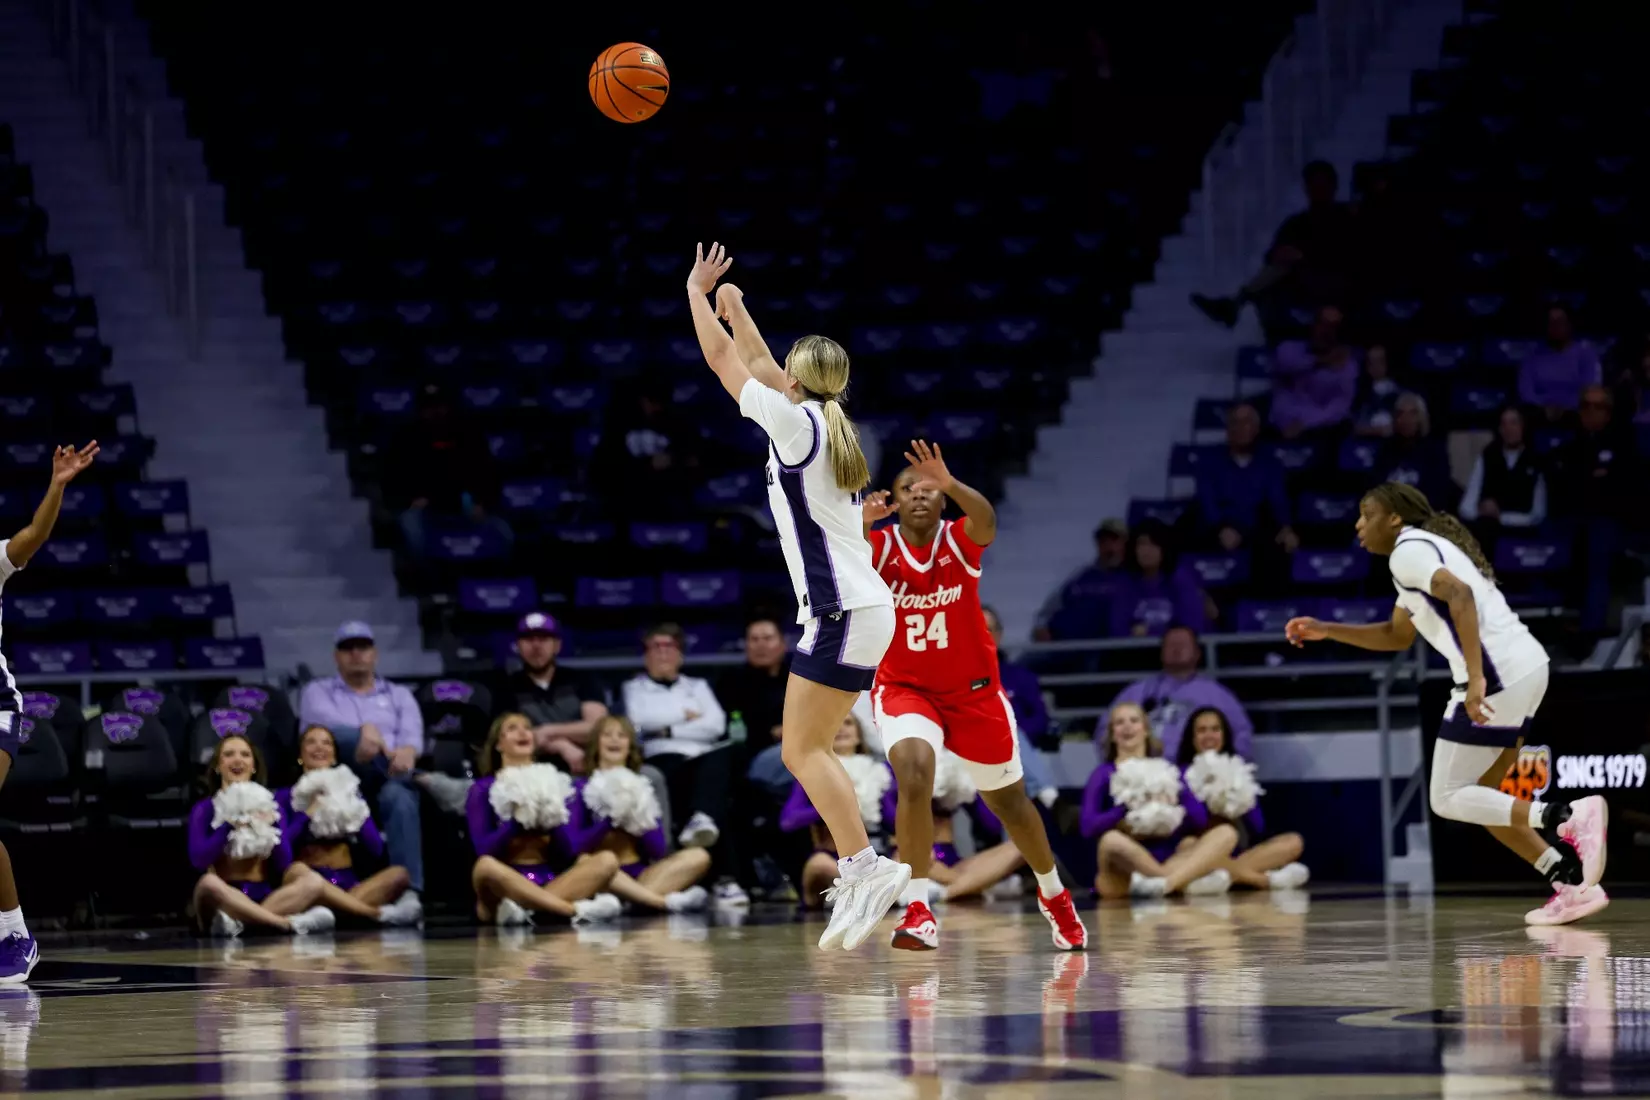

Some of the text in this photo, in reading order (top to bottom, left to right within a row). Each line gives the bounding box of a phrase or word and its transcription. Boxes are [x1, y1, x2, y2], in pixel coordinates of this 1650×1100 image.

[890, 579, 963, 609] Houston
[904, 611, 949, 652] 24
[1556, 754, 1605, 789] SINCE
[1605, 753, 1647, 788] 1979
